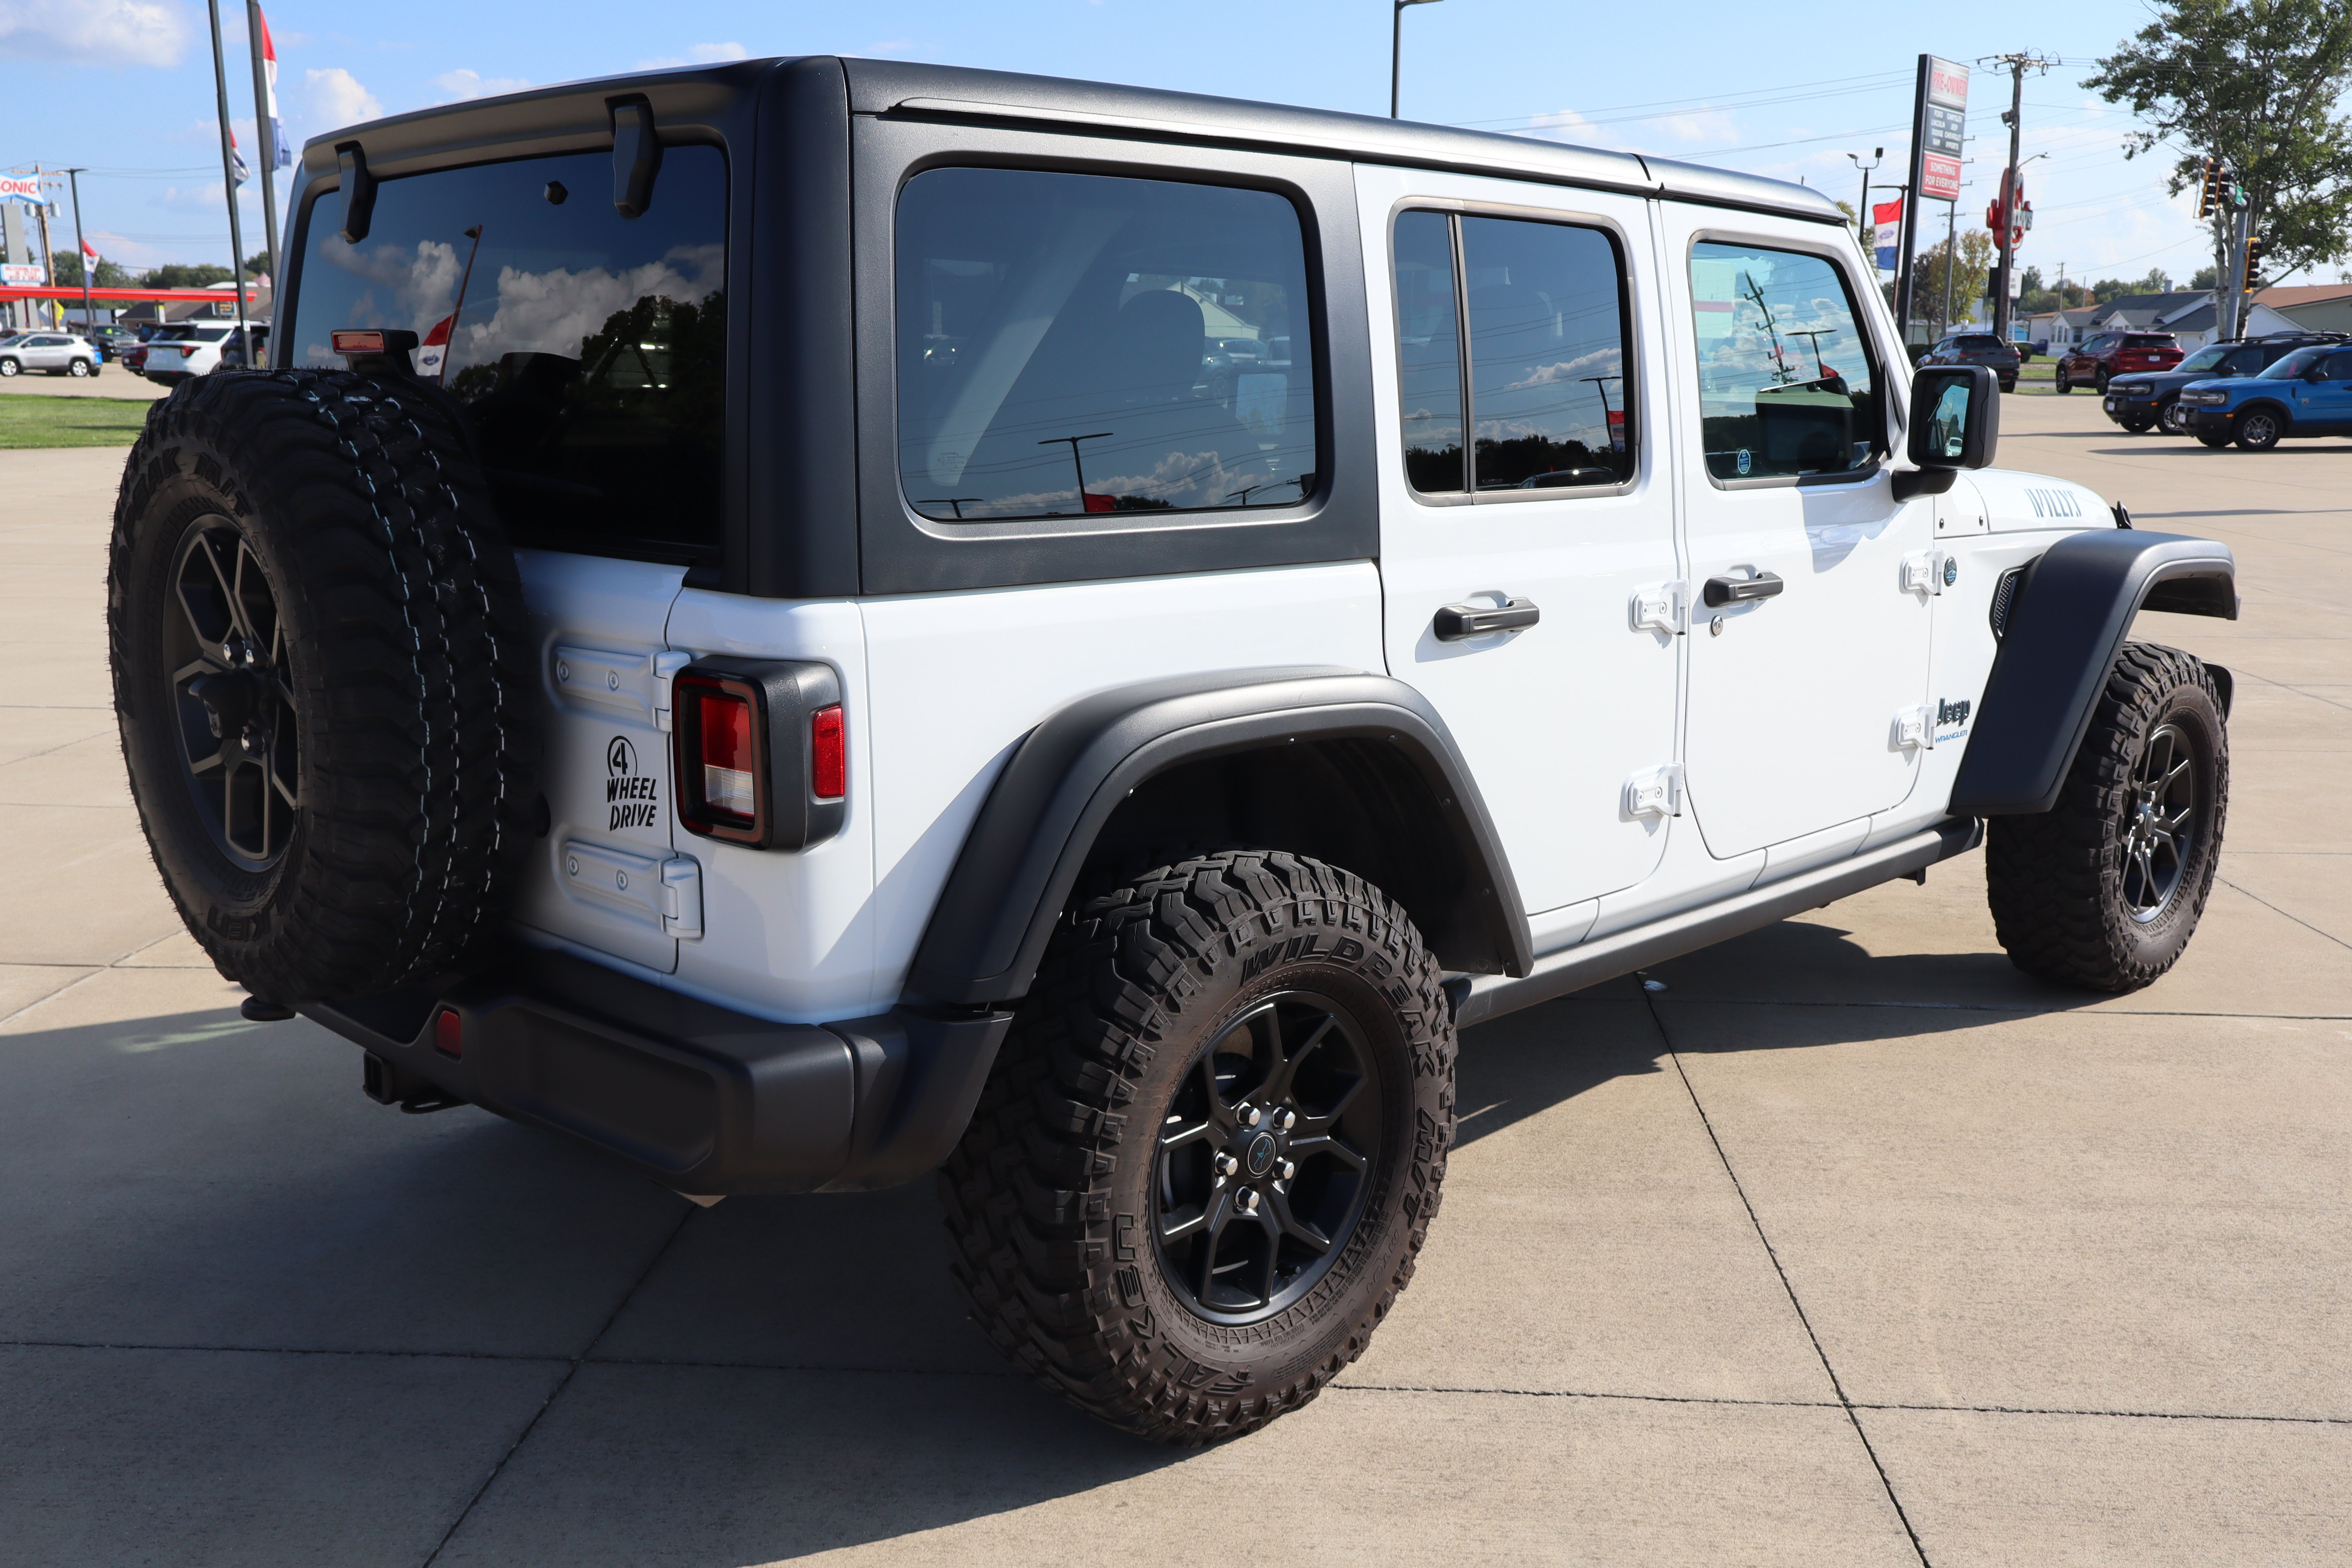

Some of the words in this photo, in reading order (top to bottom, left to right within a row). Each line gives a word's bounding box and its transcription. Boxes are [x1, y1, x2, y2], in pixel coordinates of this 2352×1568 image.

[1932, 71, 1967, 97] PRE-OWNED
[1933, 109, 1944, 118] FORD
[1930, 161, 1956, 176] SOMETHING
[0, 180, 37, 194] ONIC
[1925, 174, 1936, 185] FOR
[1936, 176, 1959, 191] EVERYONE
[2024, 488, 2081, 517] WILLYS
[1936, 697, 1971, 727] Jeep
[1935, 729, 1968, 744] WRANGLER
[612, 742, 628, 775] 4
[607, 777, 657, 803] WHEEL
[609, 803, 657, 832] DRIVE
[1238, 932, 1437, 1078] WILDPEAK
[1116, 1213, 1255, 1396] FALKEN
